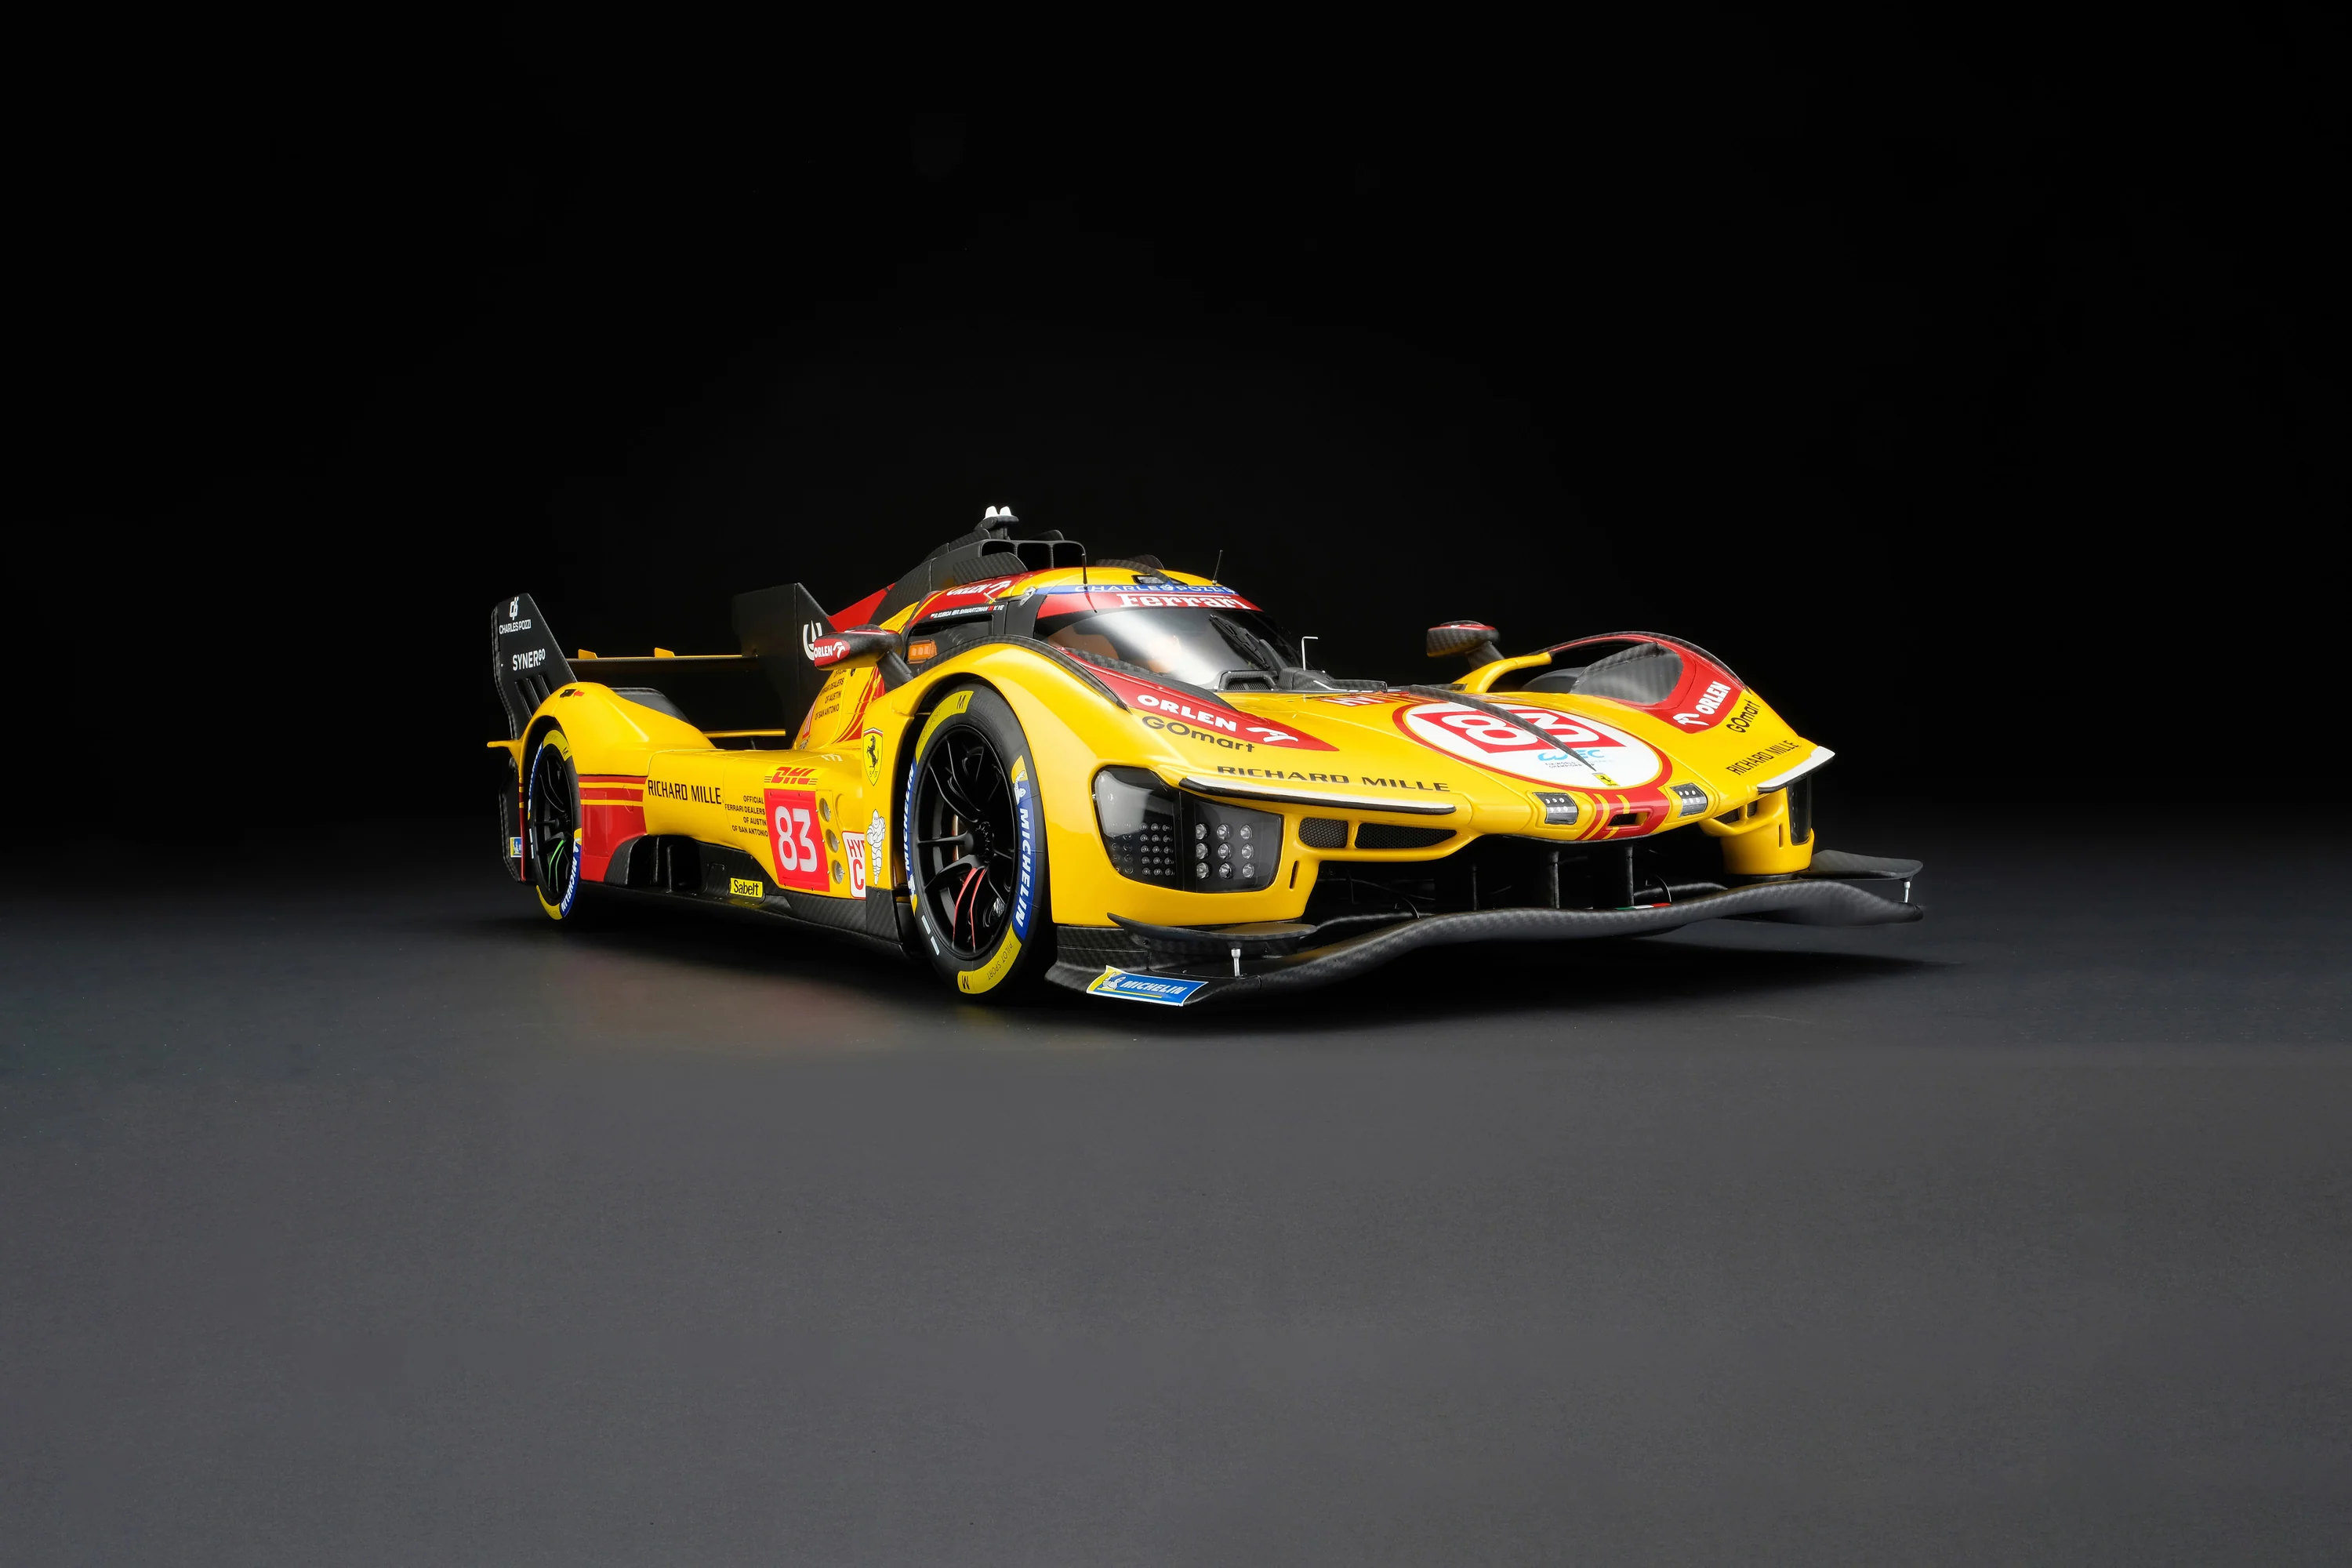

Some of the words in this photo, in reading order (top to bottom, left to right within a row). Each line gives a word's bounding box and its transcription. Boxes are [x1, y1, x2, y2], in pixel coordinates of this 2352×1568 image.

[1116, 593, 1253, 610] Ferrari
[499, 621, 519, 635] CHARLES
[519, 619, 532, 630] POZZI
[814, 645, 833, 658] ORLEN
[956, 695, 967, 710] M
[1701, 681, 1731, 716] ORLEN
[1136, 692, 1238, 733] ORLEN
[1726, 700, 1760, 733] GOmart
[1141, 716, 1255, 753] GOmart
[1441, 710, 1601, 746] 83
[1726, 750, 1773, 776] RICHARD
[1770, 739, 1800, 758] MILLE
[771, 766, 817, 785] DHL
[1217, 765, 1350, 784] RICHARD
[1361, 776, 1451, 792] MILLE
[648, 779, 688, 801] RICHARD
[691, 786, 722, 805] MILLE
[742, 795, 764, 804] OFFICIAL
[724, 804, 744, 812] FERRARI
[744, 806, 766, 815] DEALERS
[904, 761, 914, 872] MICHELIN
[748, 828, 769, 837] ANTONIO
[750, 818, 767, 826] AUSTIN
[774, 805, 818, 873] 83
[1015, 808, 1031, 927] MICHELIN
[561, 856, 578, 912] MICHELIN
[733, 878, 760, 897] Sabelt
[1000, 941, 1014, 964] PILOT
[985, 960, 1002, 981] SPORT
[961, 975, 971, 990] M
[1120, 980, 1189, 995] MICHELIN
